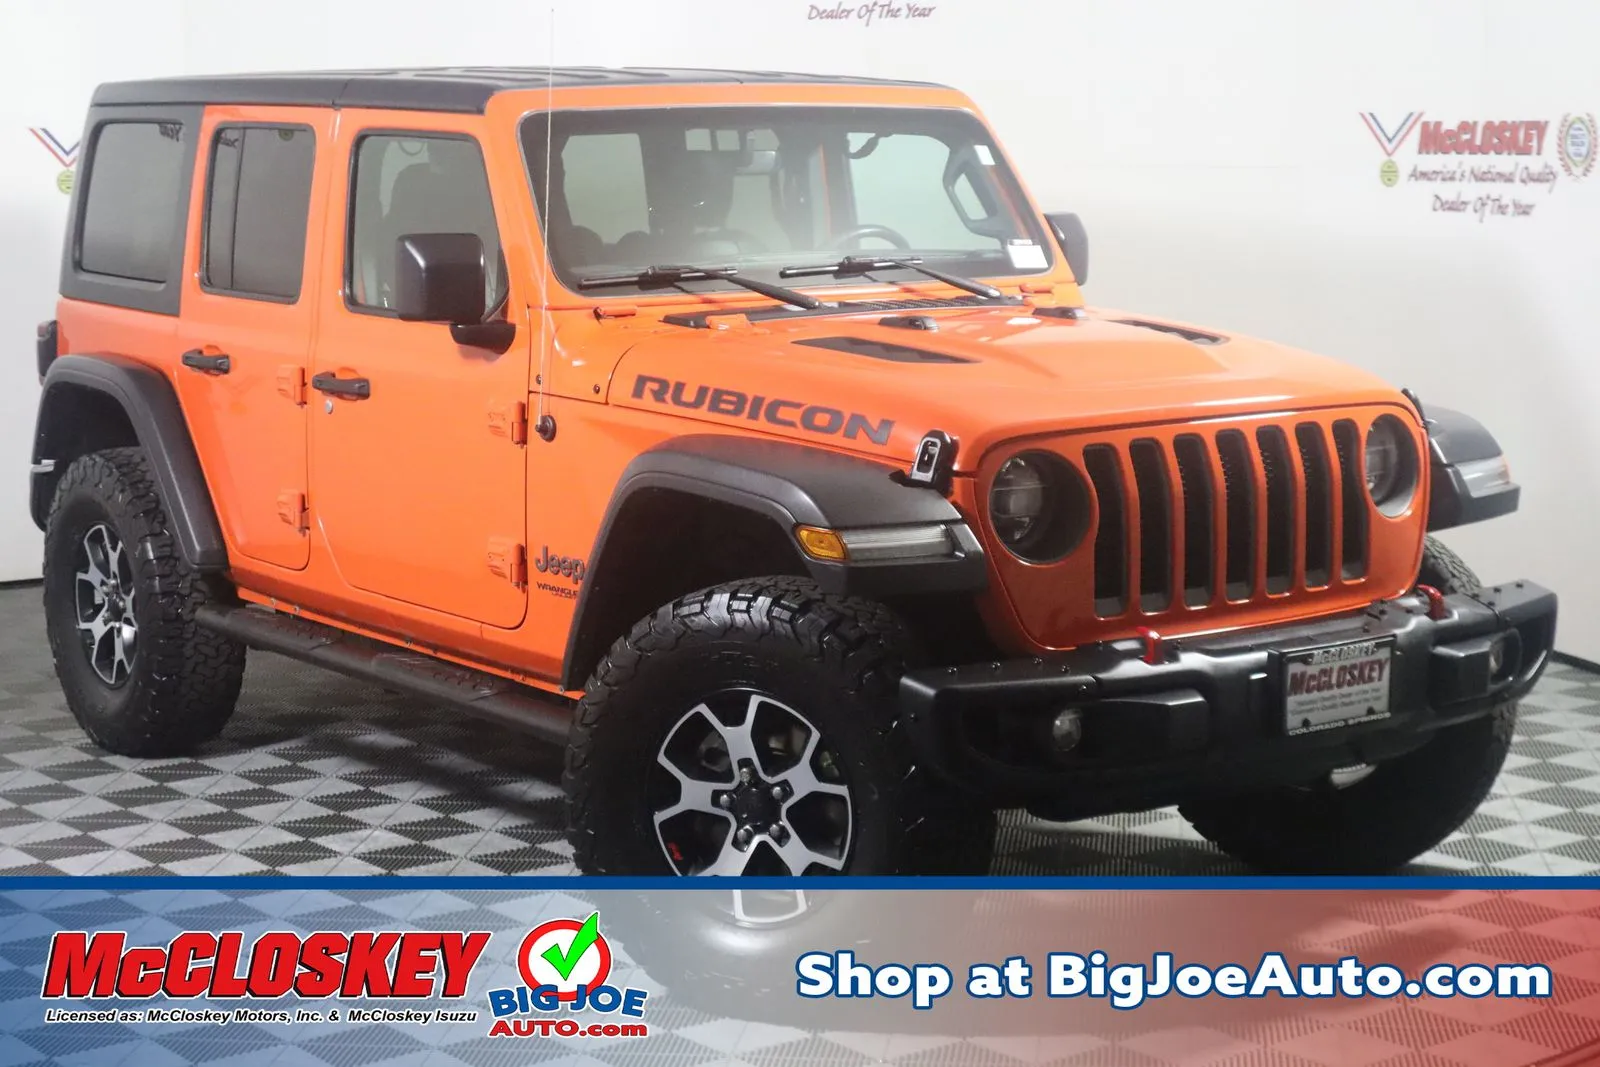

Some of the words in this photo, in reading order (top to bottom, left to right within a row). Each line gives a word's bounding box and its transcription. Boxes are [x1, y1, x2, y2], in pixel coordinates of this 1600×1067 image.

[807, 2, 854, 20] Dealer
[857, 1, 878, 27] Of
[878, 0, 902, 18] The
[904, 3, 936, 19] Year
[1418, 120, 1550, 155] McCLOSKEY
[1408, 161, 1466, 182] America's
[1468, 162, 1519, 183] National
[1519, 161, 1559, 194] Quality
[1432, 191, 1470, 212] Dealer
[1473, 194, 1490, 220] Of
[1490, 195, 1511, 216] The
[1511, 198, 1536, 217] Year
[631, 374, 897, 446] RUBICON
[535, 544, 585, 585] Jeep
[1289, 659, 1391, 696] McCLOSKEY
[1289, 720, 1345, 736] COLORADO
[1347, 711, 1392, 725] SPRINGS
